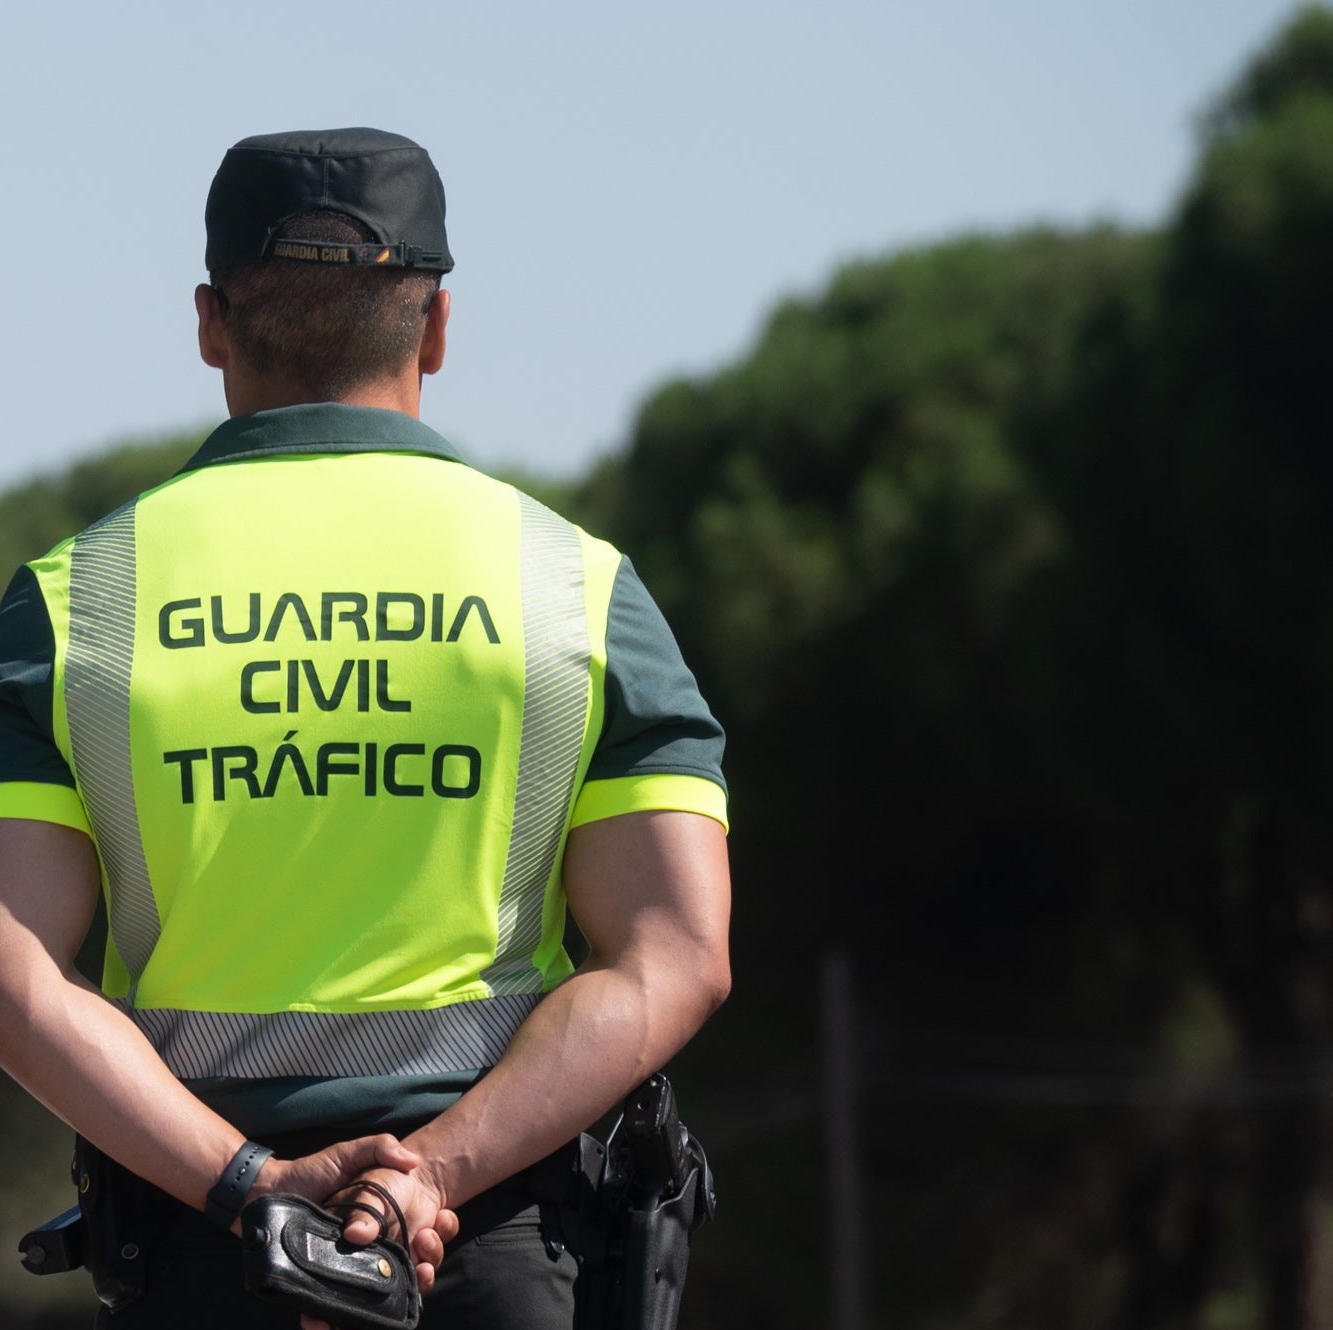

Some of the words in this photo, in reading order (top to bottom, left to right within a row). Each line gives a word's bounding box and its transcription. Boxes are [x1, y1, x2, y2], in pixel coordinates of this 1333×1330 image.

[274, 243, 319, 260] GUARDIA
[321, 248, 350, 262] CIVIL
[158, 592, 501, 650] GUARDIA
[240, 659, 412, 714] CIVIL
[163, 730, 482, 804] TRÁFICO
